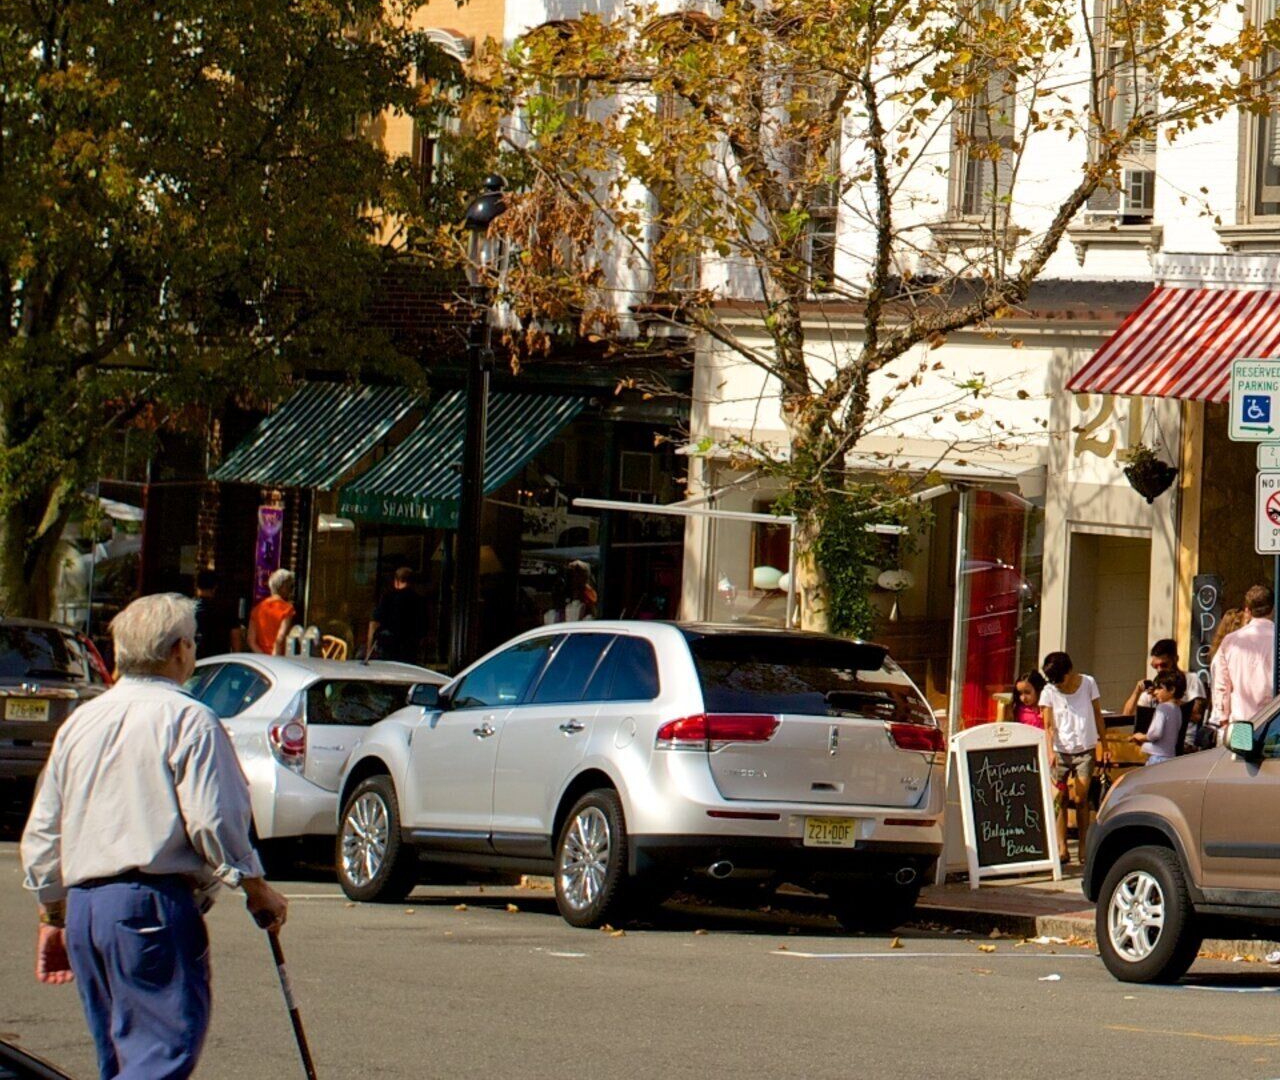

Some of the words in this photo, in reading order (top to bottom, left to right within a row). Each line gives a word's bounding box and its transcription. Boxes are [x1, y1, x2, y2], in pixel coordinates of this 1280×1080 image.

[1238, 381, 1279, 391] PARKING
[1270, 448, 1275, 456] 2
[1262, 479, 1274, 488] NO
[1271, 539, 1276, 547] 3
[976, 756, 1039, 785] Autumnal
[990, 780, 1026, 806] Reds
[982, 821, 1025, 847] Belgium
